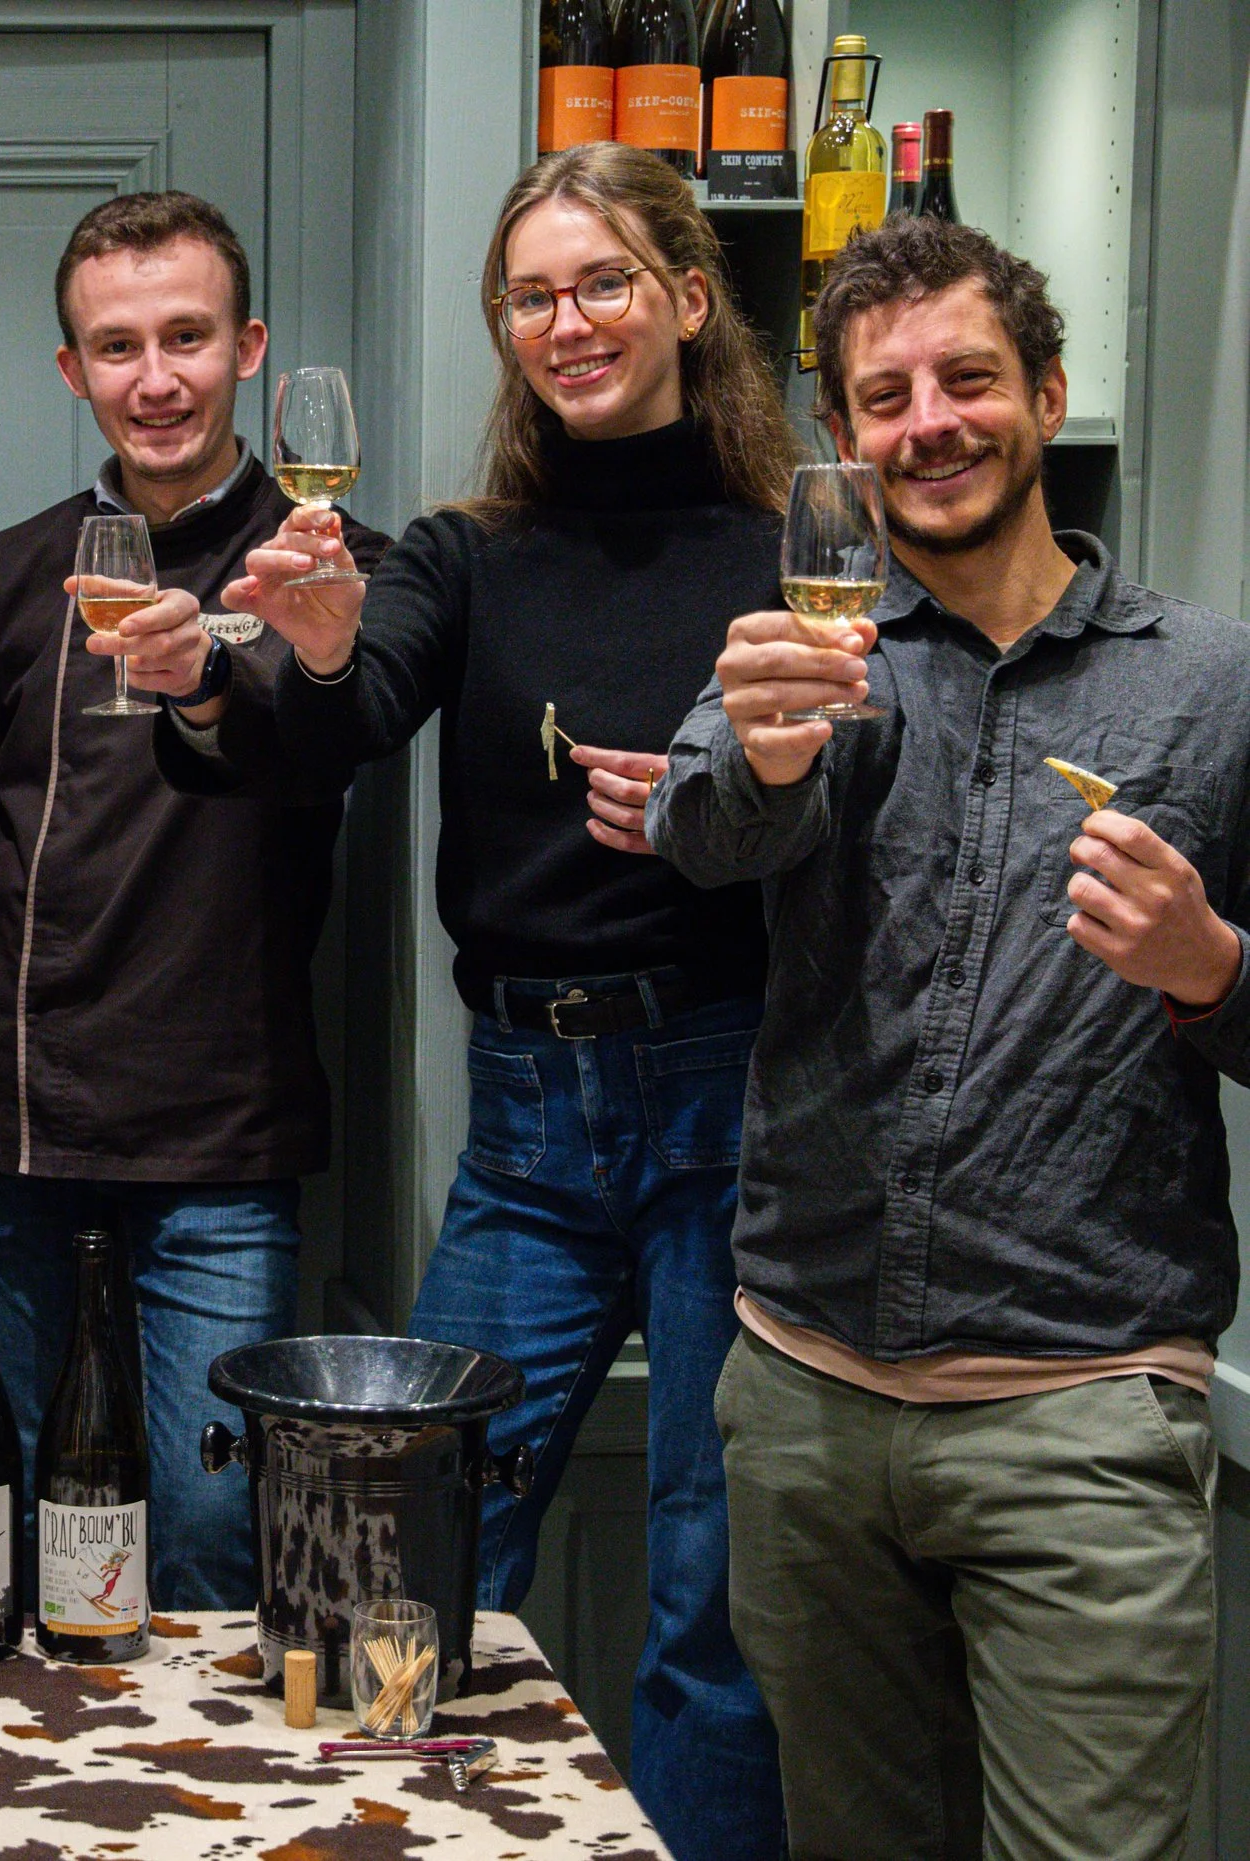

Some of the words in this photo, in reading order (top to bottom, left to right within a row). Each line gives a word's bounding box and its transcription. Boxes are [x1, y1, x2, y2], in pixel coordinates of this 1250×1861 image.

[721, 155, 742, 166] SKIN
[745, 155, 783, 166] CONTACT
[44, 1508, 76, 1559] CRAC
[49, 1622, 80, 1634] DOMAINE
